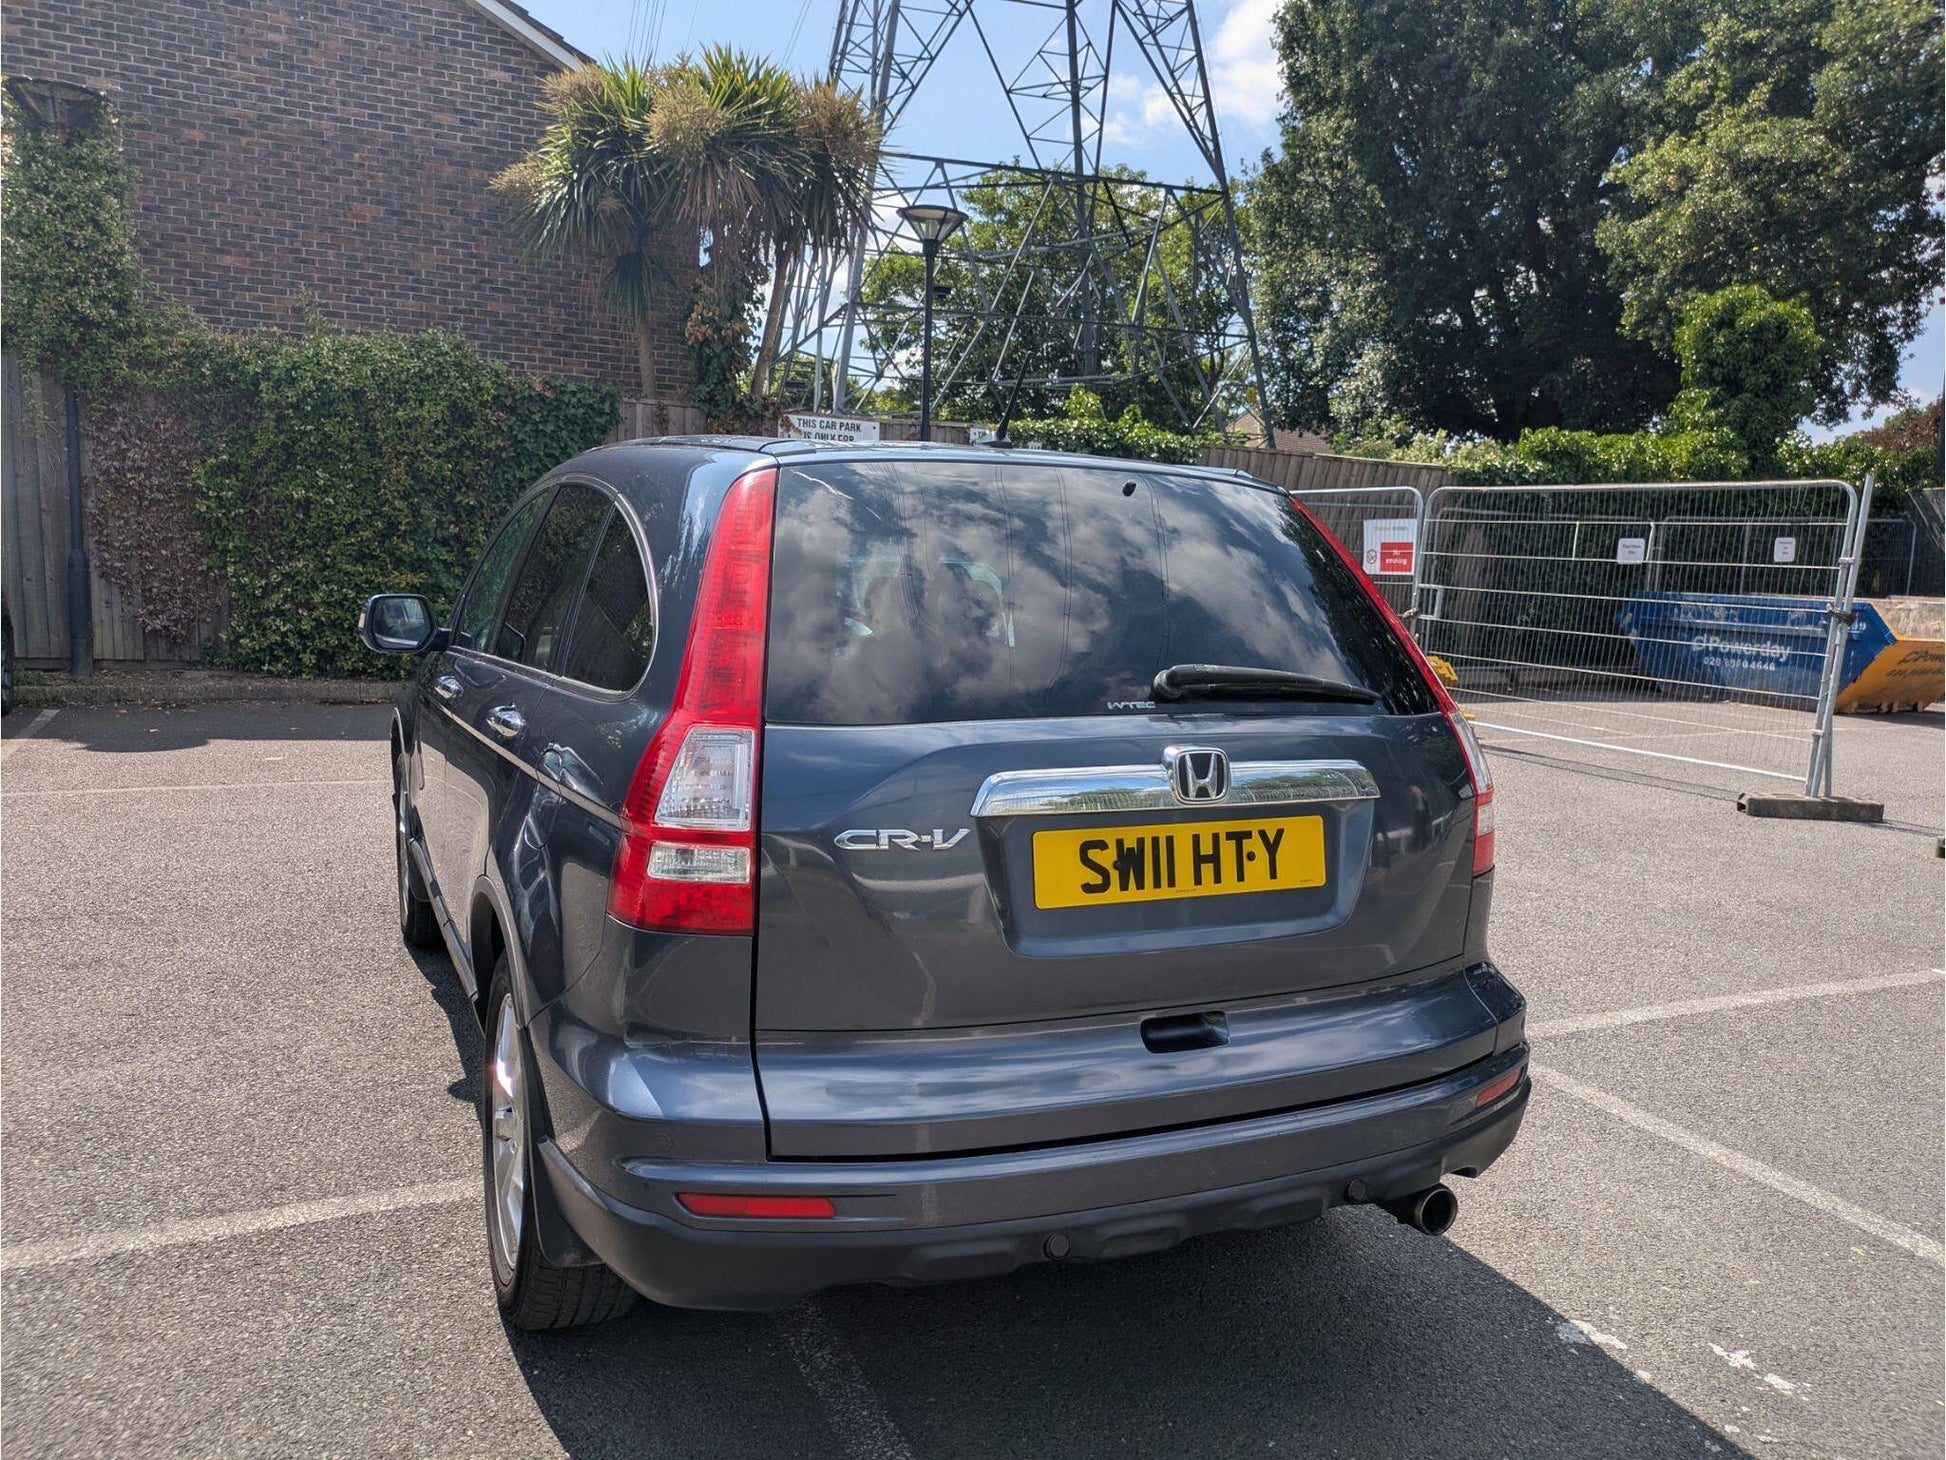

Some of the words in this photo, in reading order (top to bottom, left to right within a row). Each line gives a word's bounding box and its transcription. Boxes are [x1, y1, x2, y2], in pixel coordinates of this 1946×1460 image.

[797, 417, 817, 429] THIS
[819, 419, 837, 431] CAR
[839, 421, 862, 433] PARK
[837, 434, 855, 442] FOR
[833, 828, 972, 852] CR-V
[1191, 828, 1285, 886] HTY
